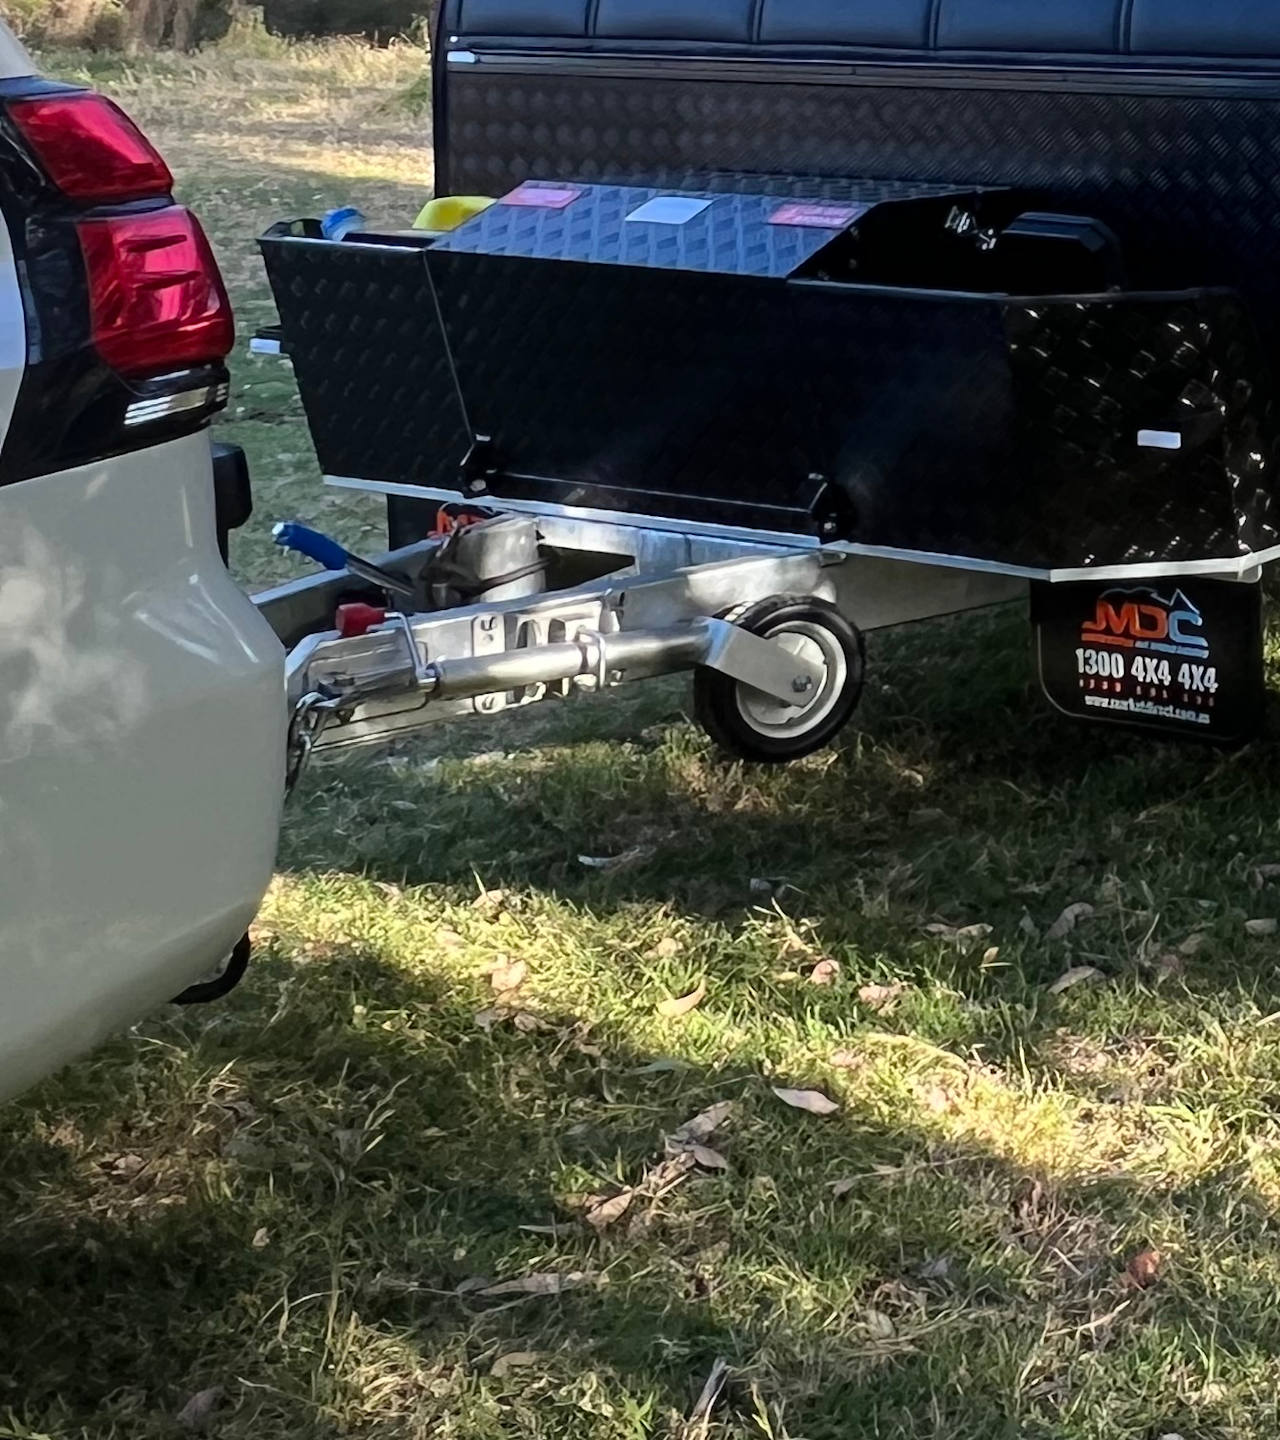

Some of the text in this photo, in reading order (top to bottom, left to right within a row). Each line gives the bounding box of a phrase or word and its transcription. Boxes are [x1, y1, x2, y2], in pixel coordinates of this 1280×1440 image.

[1081, 598, 1209, 648] MDC
[1075, 647, 1125, 679] 1300
[1130, 655, 1172, 686] 4X4
[1177, 662, 1219, 694] 4X4
